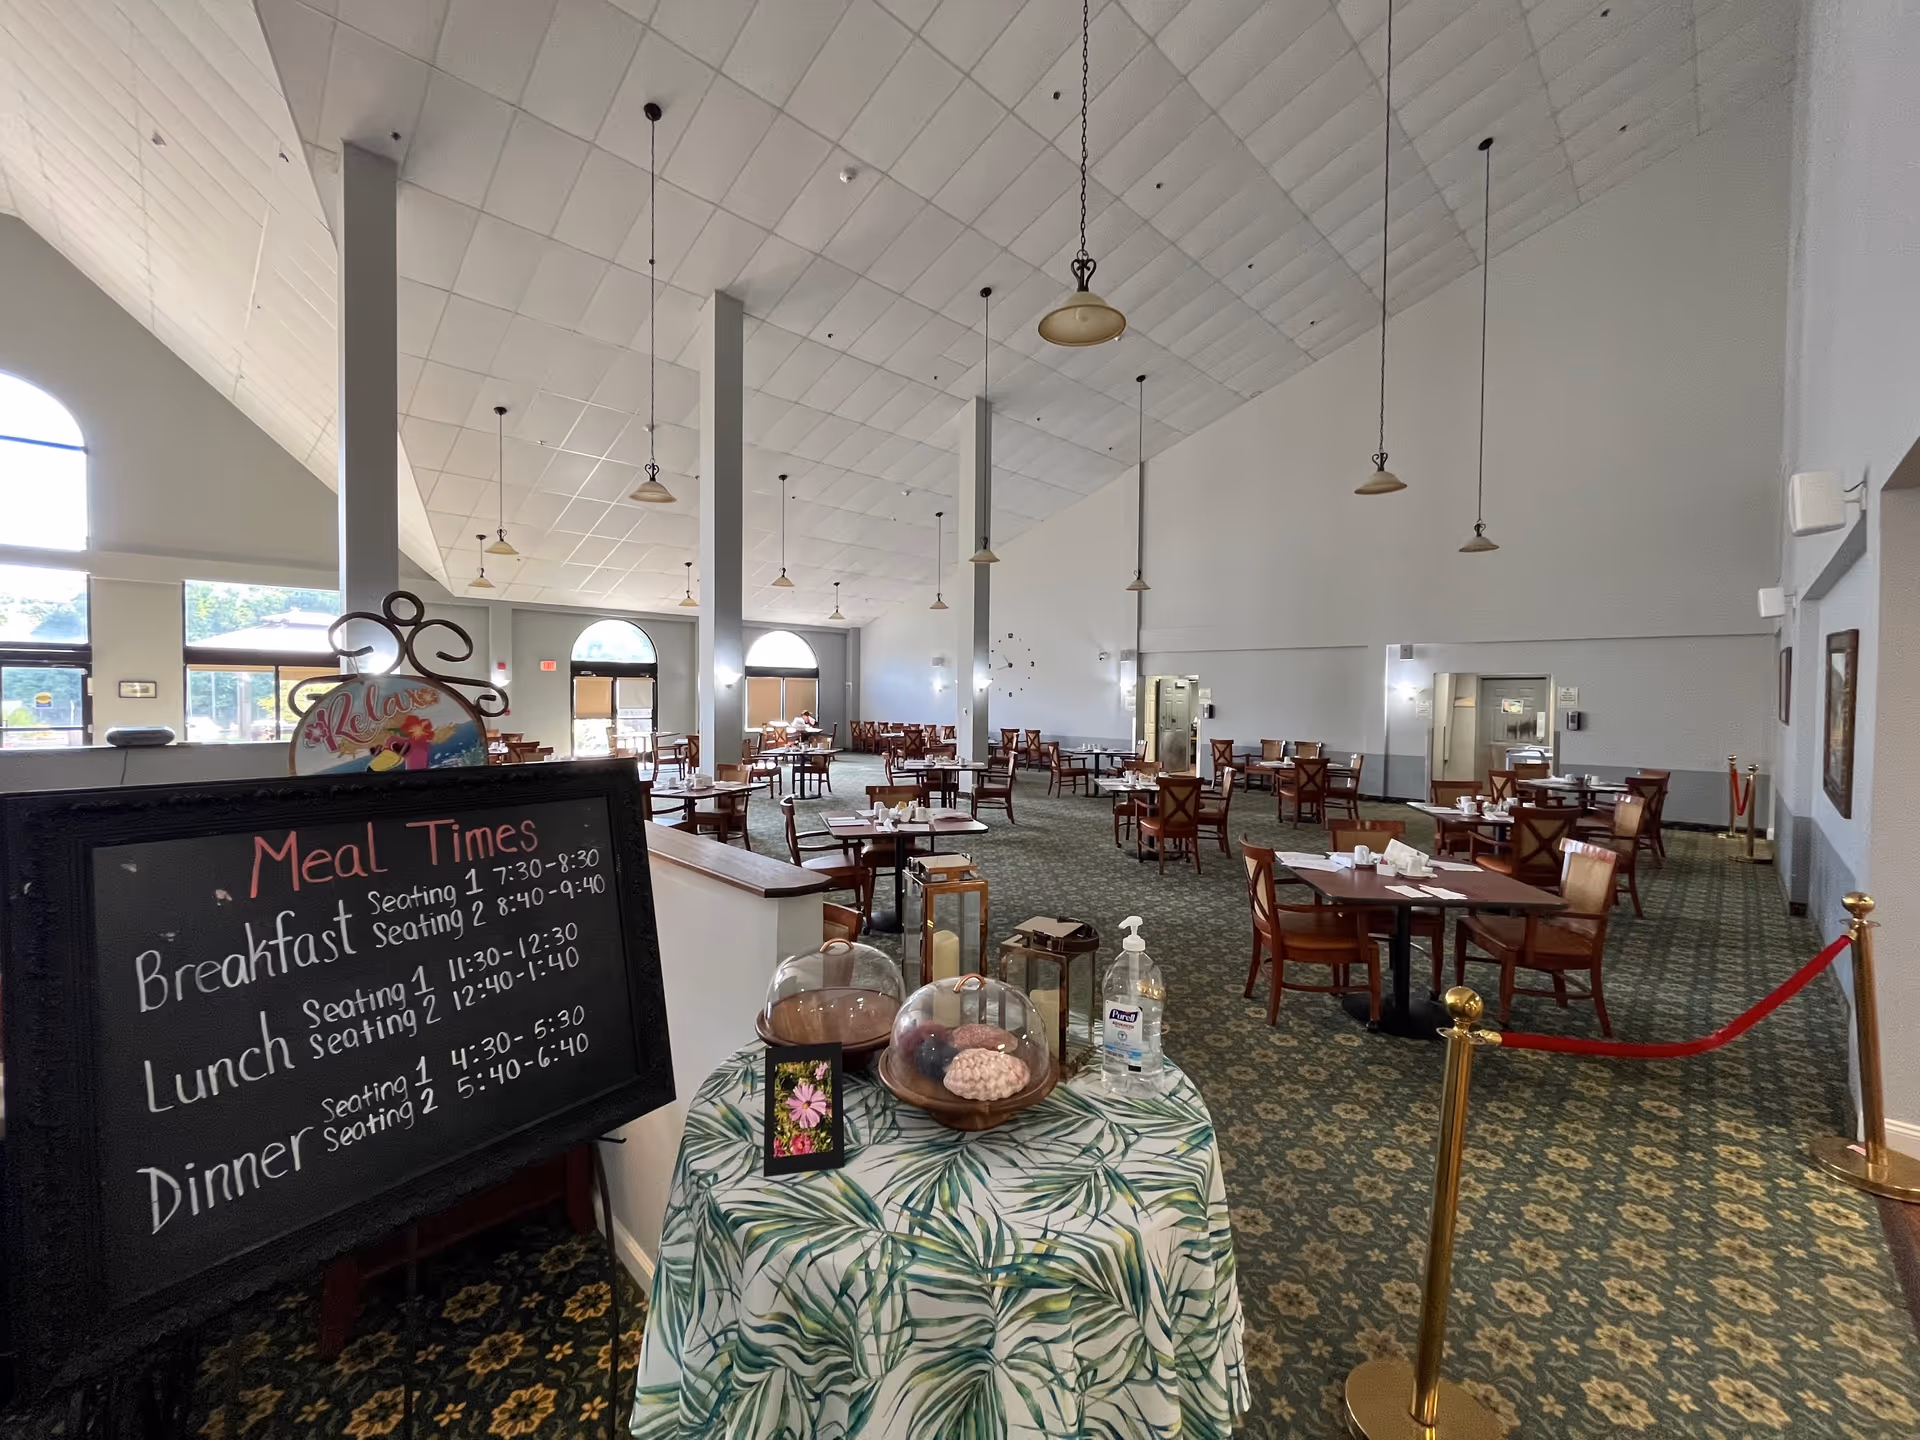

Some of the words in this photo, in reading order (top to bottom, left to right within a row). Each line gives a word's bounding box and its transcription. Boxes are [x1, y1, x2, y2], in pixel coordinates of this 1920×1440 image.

[249, 822, 388, 898] Meal
[406, 820, 538, 865] Times
[367, 884, 457, 914] Seating
[464, 868, 484, 895] 1
[493, 848, 600, 886] 7:30-8:30
[372, 909, 464, 948] Seating
[472, 900, 486, 927] 2
[497, 874, 606, 916] 8:40-9:40
[135, 899, 357, 1013] Breakfast
[302, 982, 406, 1029] Seating
[411, 965, 435, 996] 1
[449, 922, 578, 982] 11:30-12:30
[422, 994, 442, 1025] 2
[452, 946, 580, 1011] 12:40-1:40
[1112, 1009, 1136, 1022] Purell
[144, 1010, 296, 1113] Lunch
[321, 1075, 408, 1124] Seating
[414, 1056, 433, 1087] 1
[323, 1100, 415, 1152] Seating
[420, 1087, 439, 1115] 2
[457, 1032, 590, 1099] 5:40-6:40
[136, 1126, 315, 1236] Dinner
